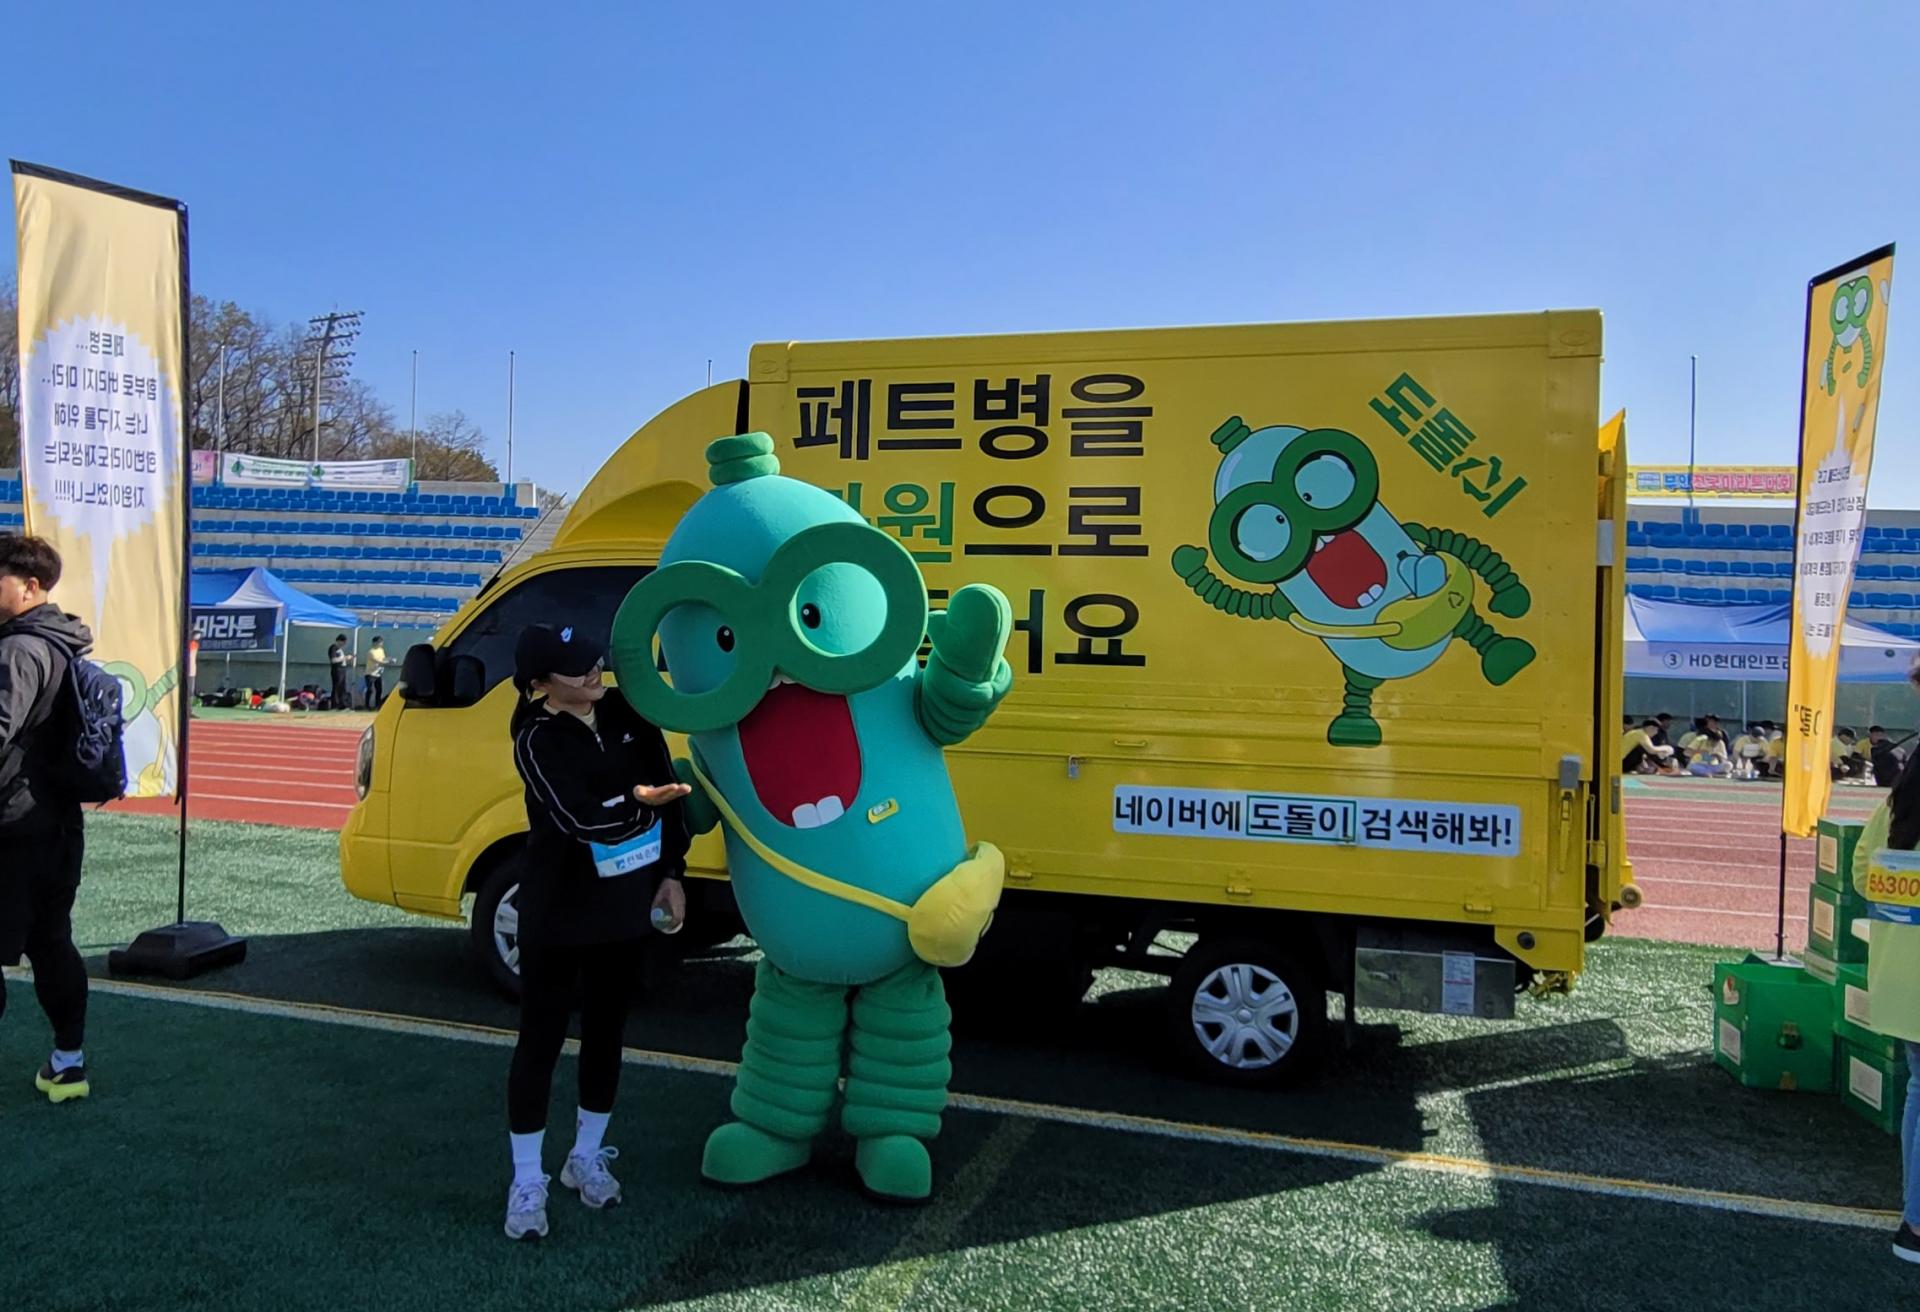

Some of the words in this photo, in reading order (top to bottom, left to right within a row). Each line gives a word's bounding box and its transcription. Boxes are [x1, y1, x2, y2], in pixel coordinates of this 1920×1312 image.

[792, 372, 1153, 460] 페트병을
[193, 615, 256, 638] 마라톤
[1115, 795, 1241, 832] 네이버에
[1250, 801, 1351, 838] 도돌이
[1361, 807, 1513, 848] 검색해봐!
